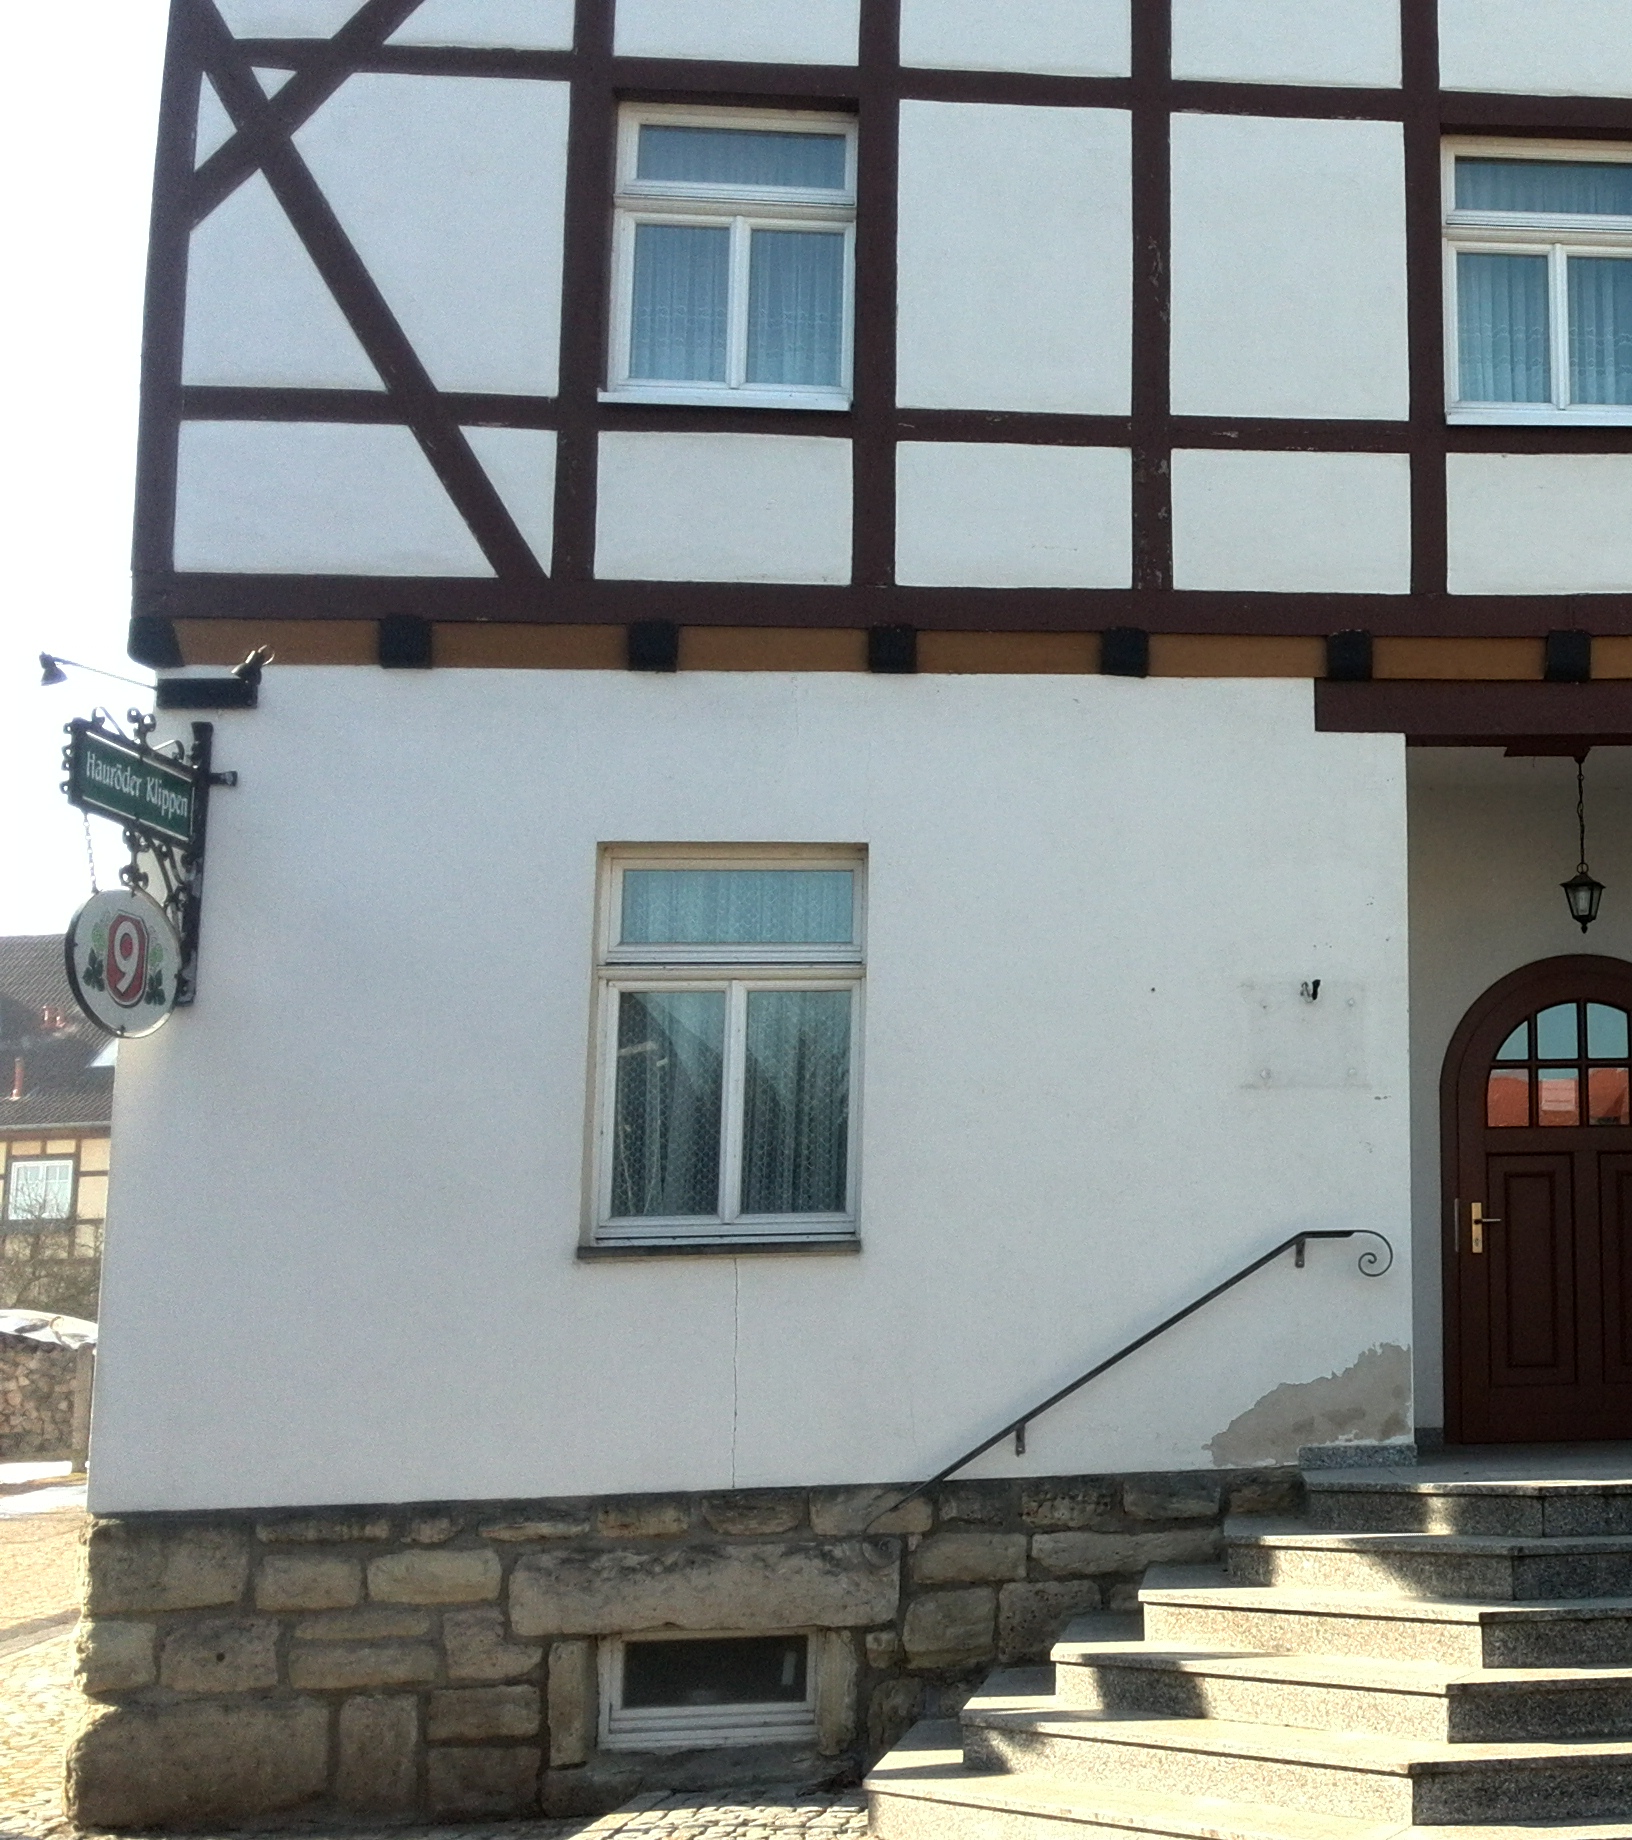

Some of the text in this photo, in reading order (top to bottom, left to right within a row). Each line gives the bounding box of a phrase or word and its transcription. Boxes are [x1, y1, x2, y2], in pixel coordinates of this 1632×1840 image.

[86, 751, 188, 818] Hauröder Klippen
[113, 921, 140, 994] 9
